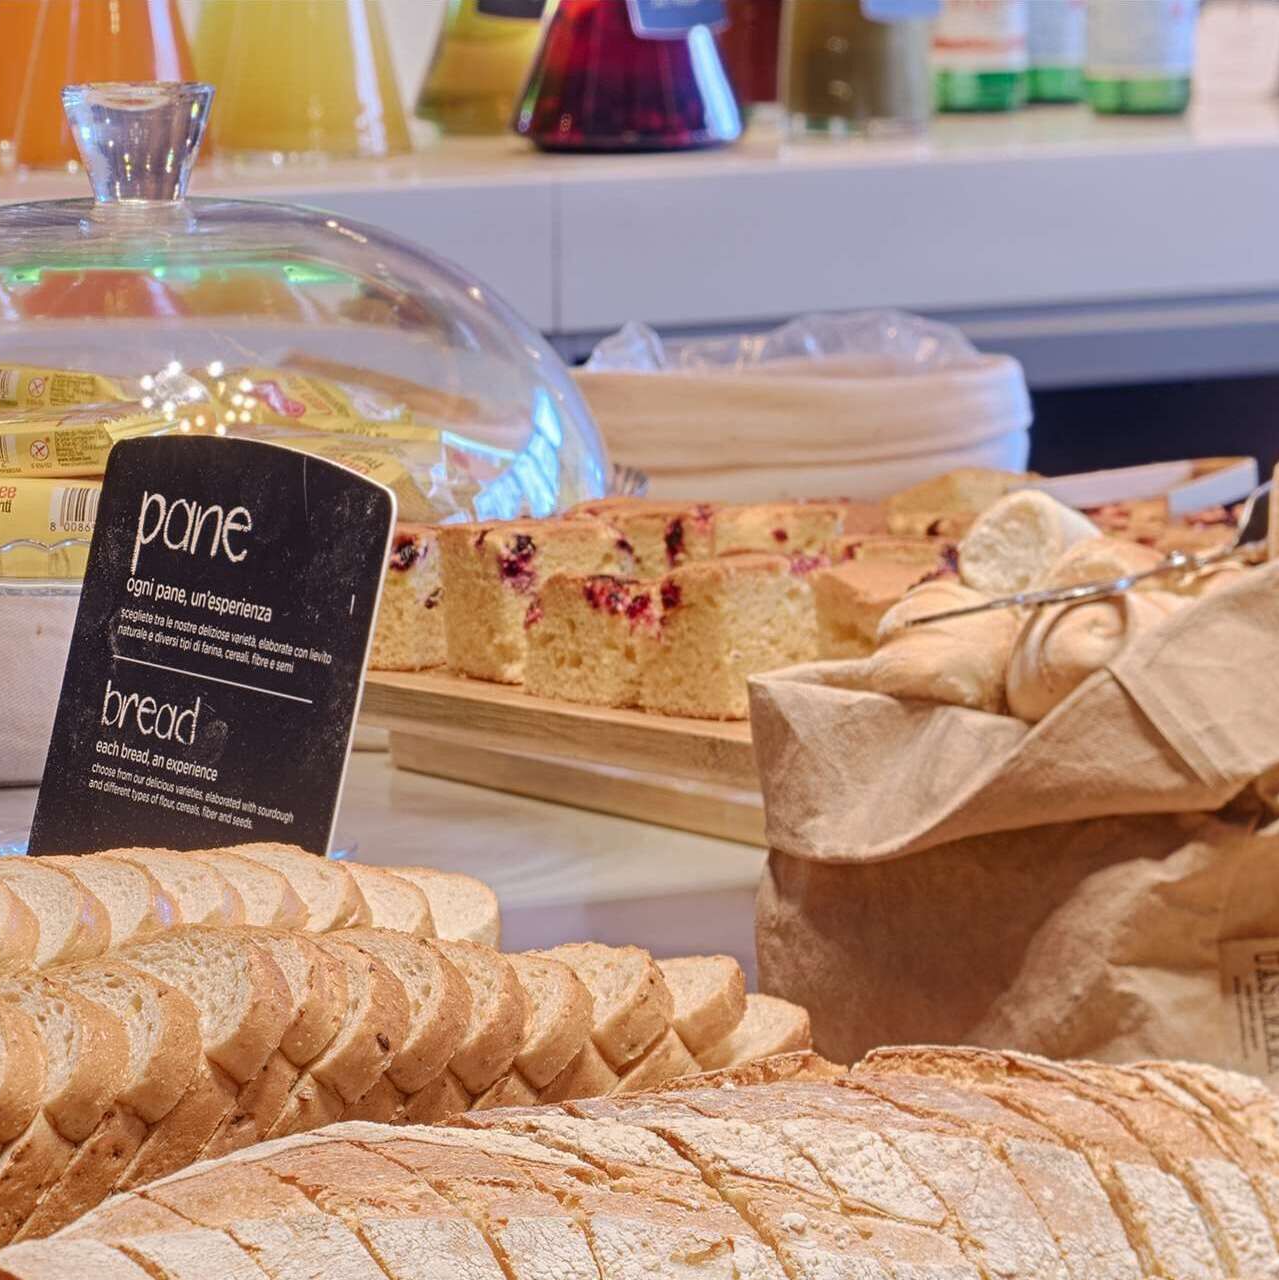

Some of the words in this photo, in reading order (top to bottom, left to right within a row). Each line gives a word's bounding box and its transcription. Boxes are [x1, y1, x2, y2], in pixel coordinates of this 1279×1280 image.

[49, 521, 57, 532] 8
[63, 521, 95, 532] 0086
[129, 490, 254, 576] pane
[126, 576, 155, 598] ogni
[154, 582, 188, 608] pane,
[190, 589, 273, 623] un'esperienza
[116, 623, 148, 641] naturale
[154, 629, 180, 648] diversi
[179, 634, 193, 652] tipi
[192, 636, 201, 652] di
[201, 638, 224, 660] farina,
[224, 646, 251, 666] cereali,
[251, 650, 269, 668] fibre
[275, 658, 295, 674] semi
[120, 606, 154, 626] scegliete
[154, 612, 165, 627] tra
[165, 614, 173, 629] le
[173, 618, 198, 636] nostre
[198, 621, 230, 642] deliziose
[230, 628, 258, 648] varietà,
[258, 633, 293, 656] elaborate
[293, 644, 308, 659] con
[308, 645, 333, 665] lievito
[100, 680, 201, 746] bread
[96, 738, 120, 759] each
[120, 742, 151, 767] bread,
[152, 751, 166, 769] an
[166, 756, 219, 783] experience
[88, 777, 104, 791] and
[103, 778, 131, 799] different
[130, 787, 150, 805] types
[150, 791, 160, 806] of
[159, 793, 176, 811] flour,
[201, 804, 218, 821] fiber
[218, 809, 232, 825] and
[232, 812, 254, 831] seeds.
[90, 762, 117, 780] choose
[116, 766, 133, 783] from
[132, 772, 145, 786] our
[145, 773, 175, 794] delicious
[204, 790, 242, 812] elaborated
[242, 798, 258, 814] with
[257, 802, 294, 826] sourdough
